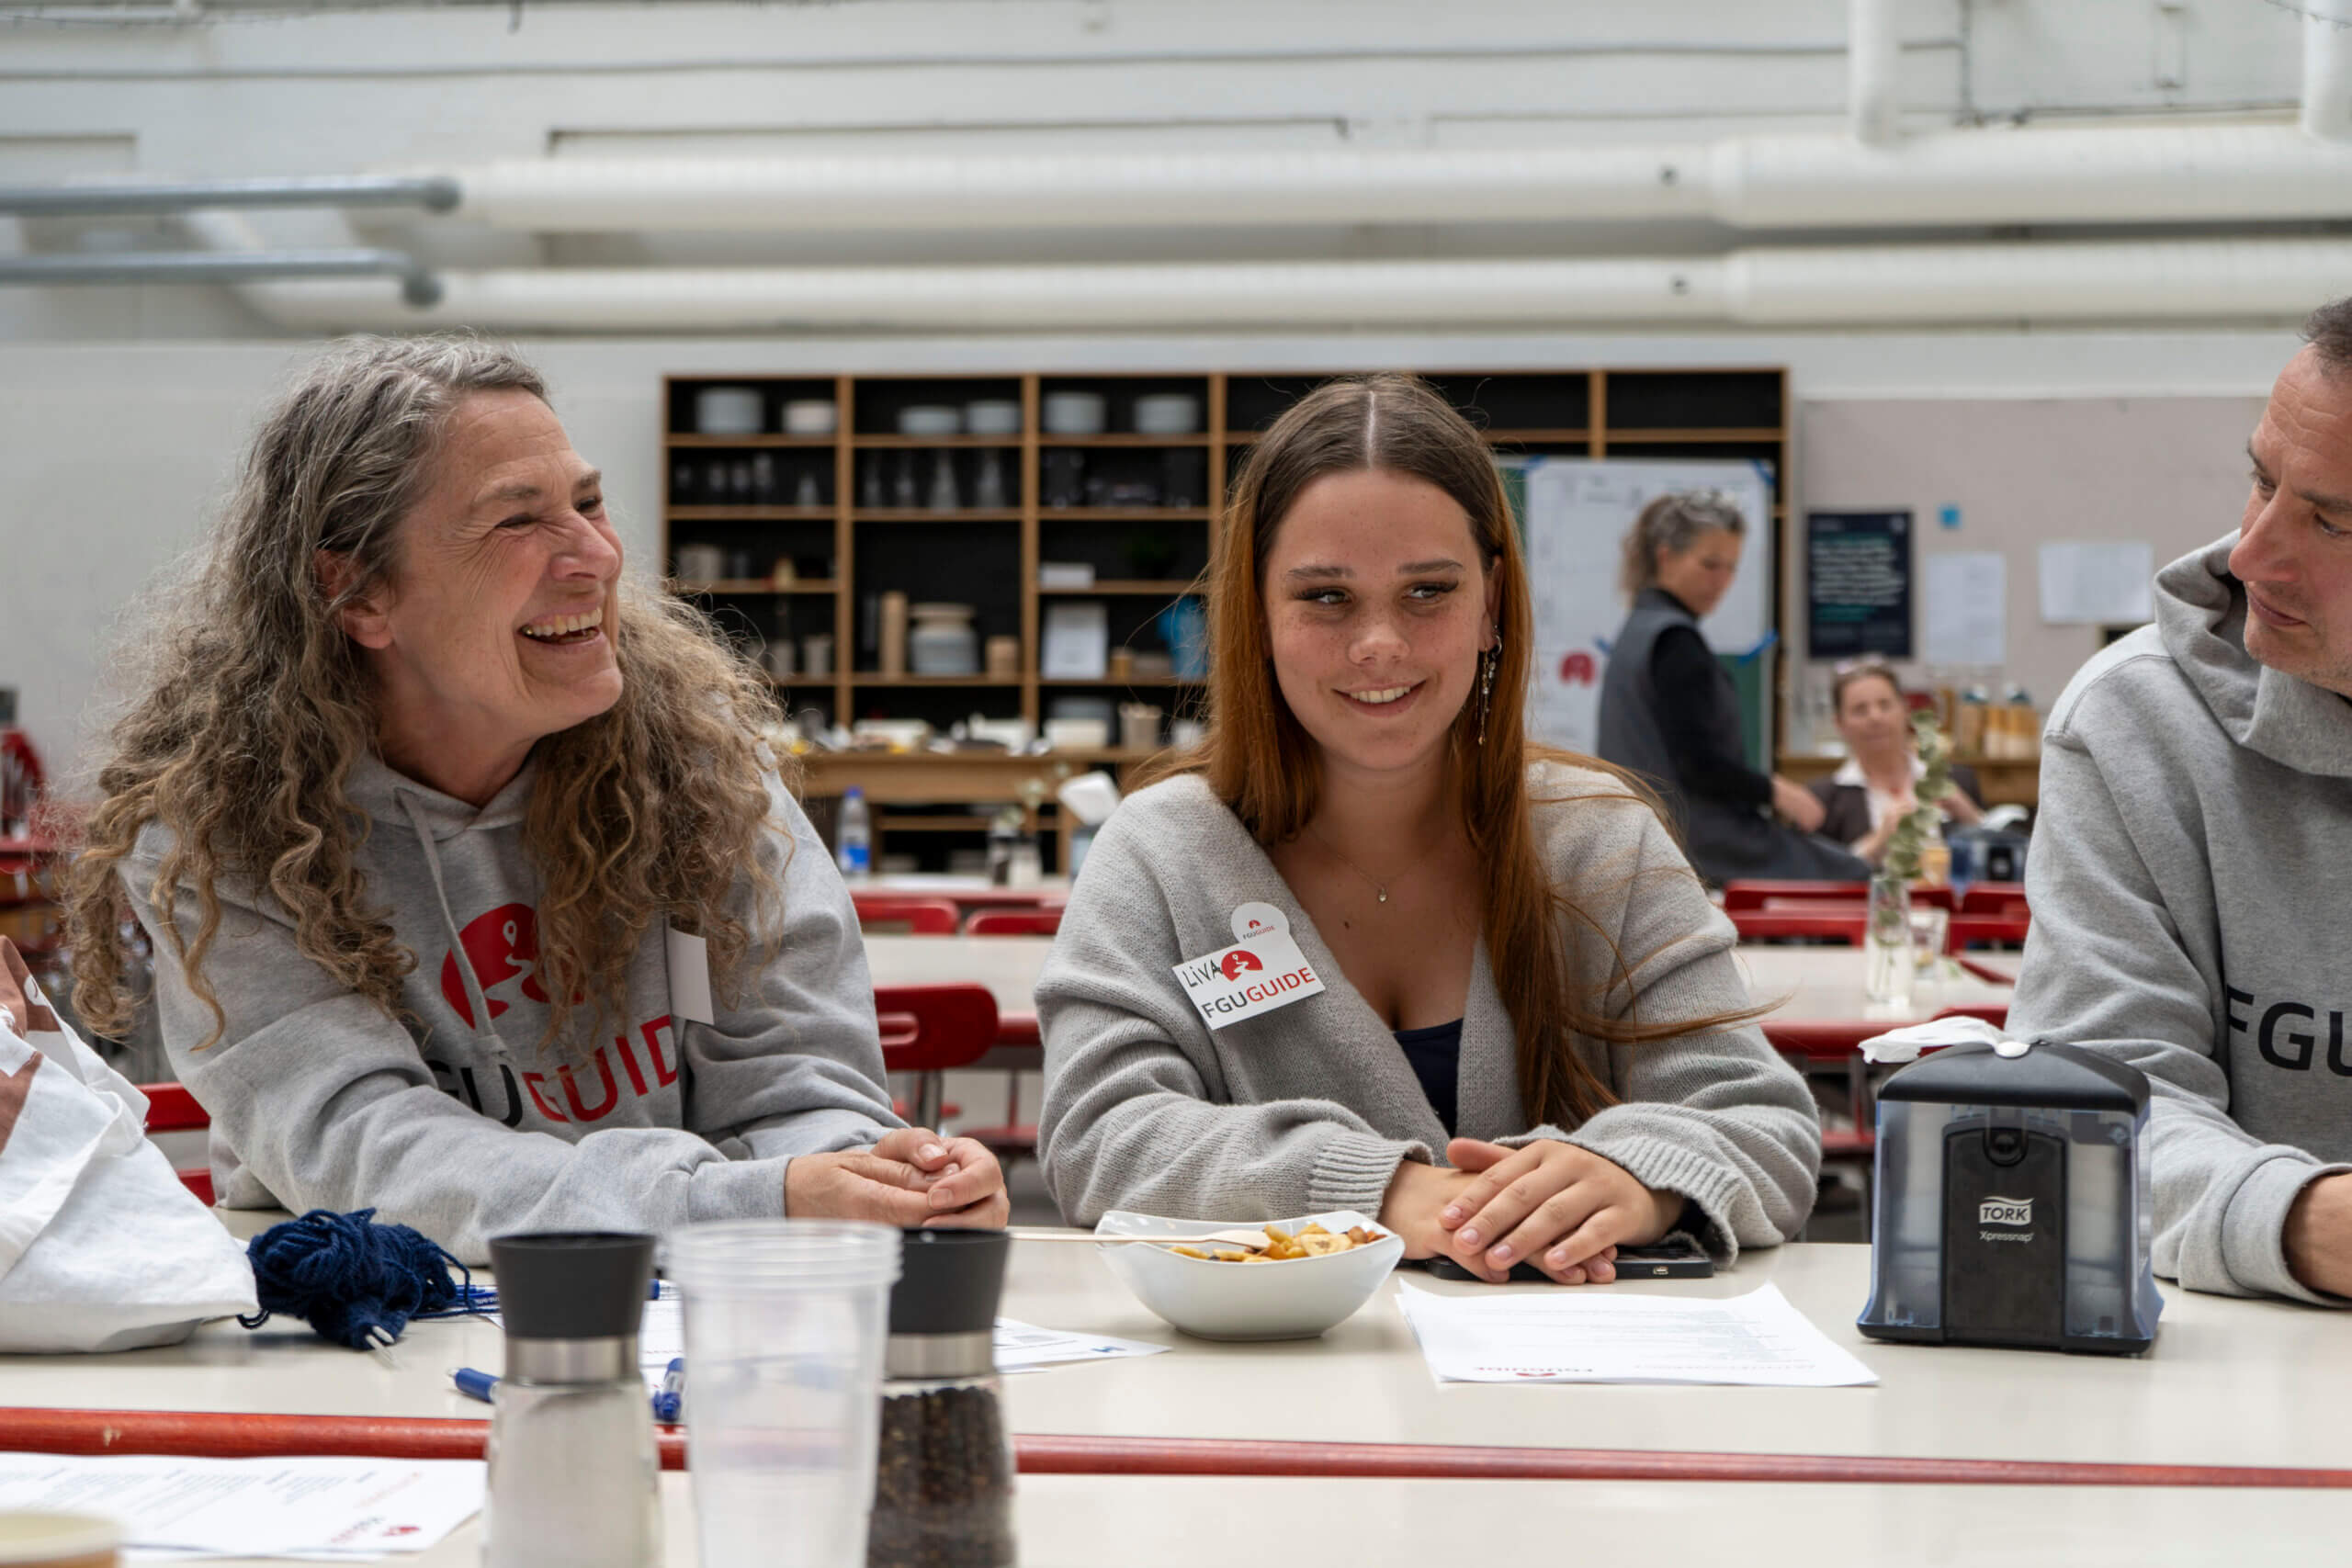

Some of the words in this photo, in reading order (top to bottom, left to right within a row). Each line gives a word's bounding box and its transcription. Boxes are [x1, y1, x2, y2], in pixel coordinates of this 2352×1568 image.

[1242, 925, 1276, 940] FGUGUIDE
[1201, 966, 1316, 1019] FGUGUIDE
[1982, 1206, 2028, 1221] TORK
[1979, 1231, 2033, 1244] Xpressnap
